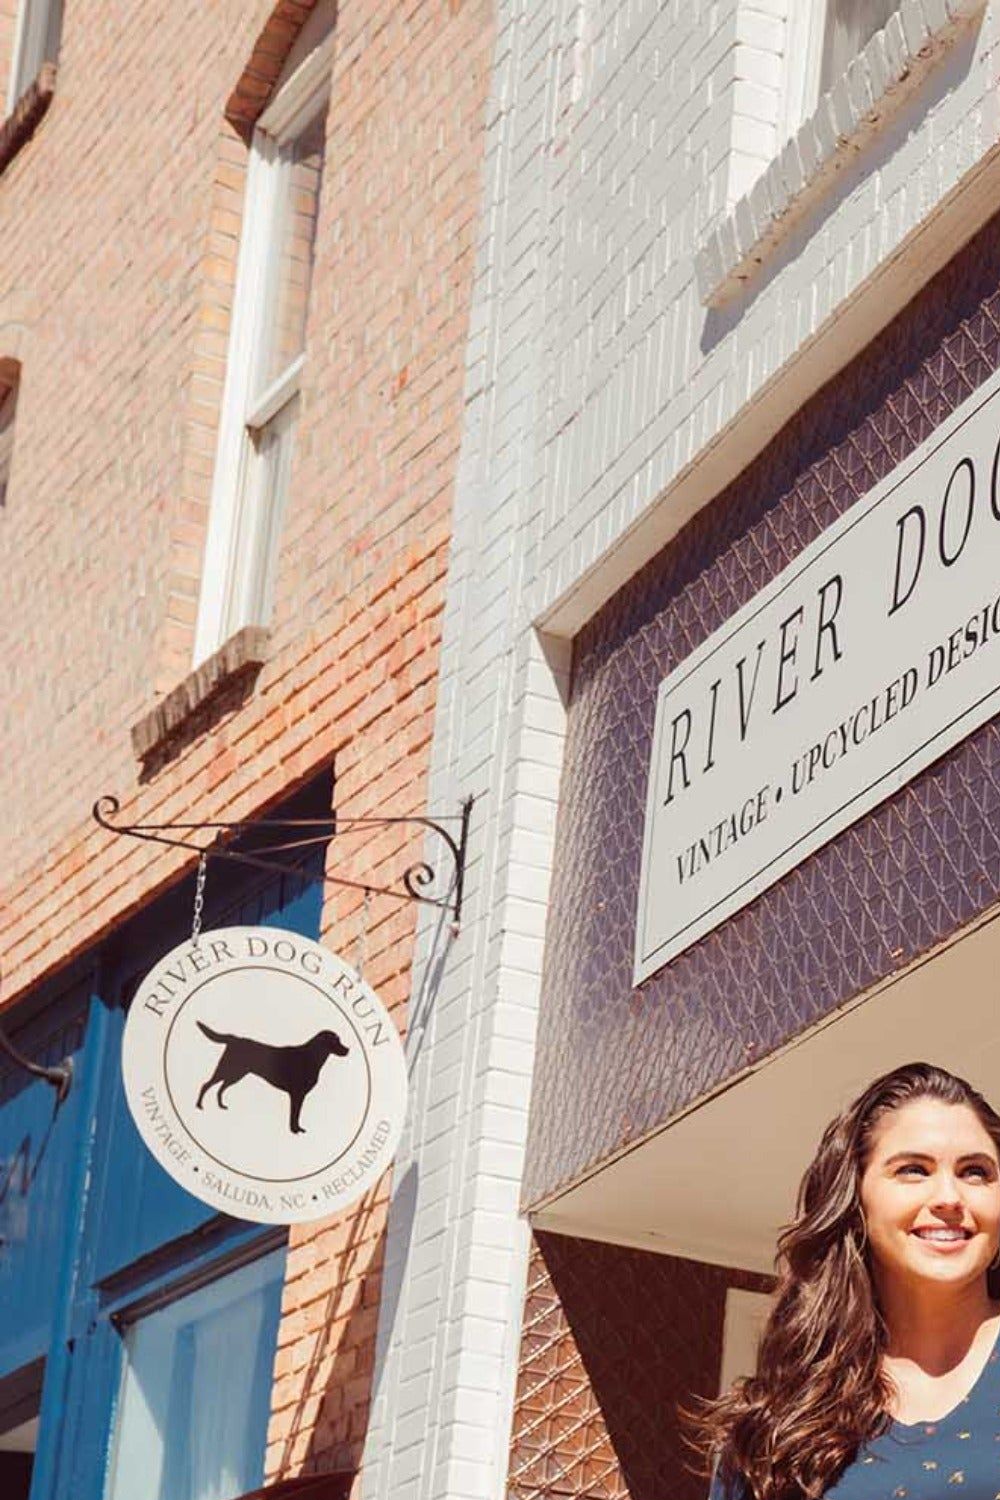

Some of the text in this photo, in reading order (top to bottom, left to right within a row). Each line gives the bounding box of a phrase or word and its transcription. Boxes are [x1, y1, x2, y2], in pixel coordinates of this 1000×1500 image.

[664, 575, 842, 806] RIVER
[675, 786, 768, 884] VINTAGE
[790, 668, 917, 796] UPCYCLED
[144, 937, 389, 1048] RIVER DOG RUN
[141, 1088, 193, 1165] VINTAGE
[279, 1193, 306, 1210] NC
[323, 1120, 391, 1199] RECLAIMED
